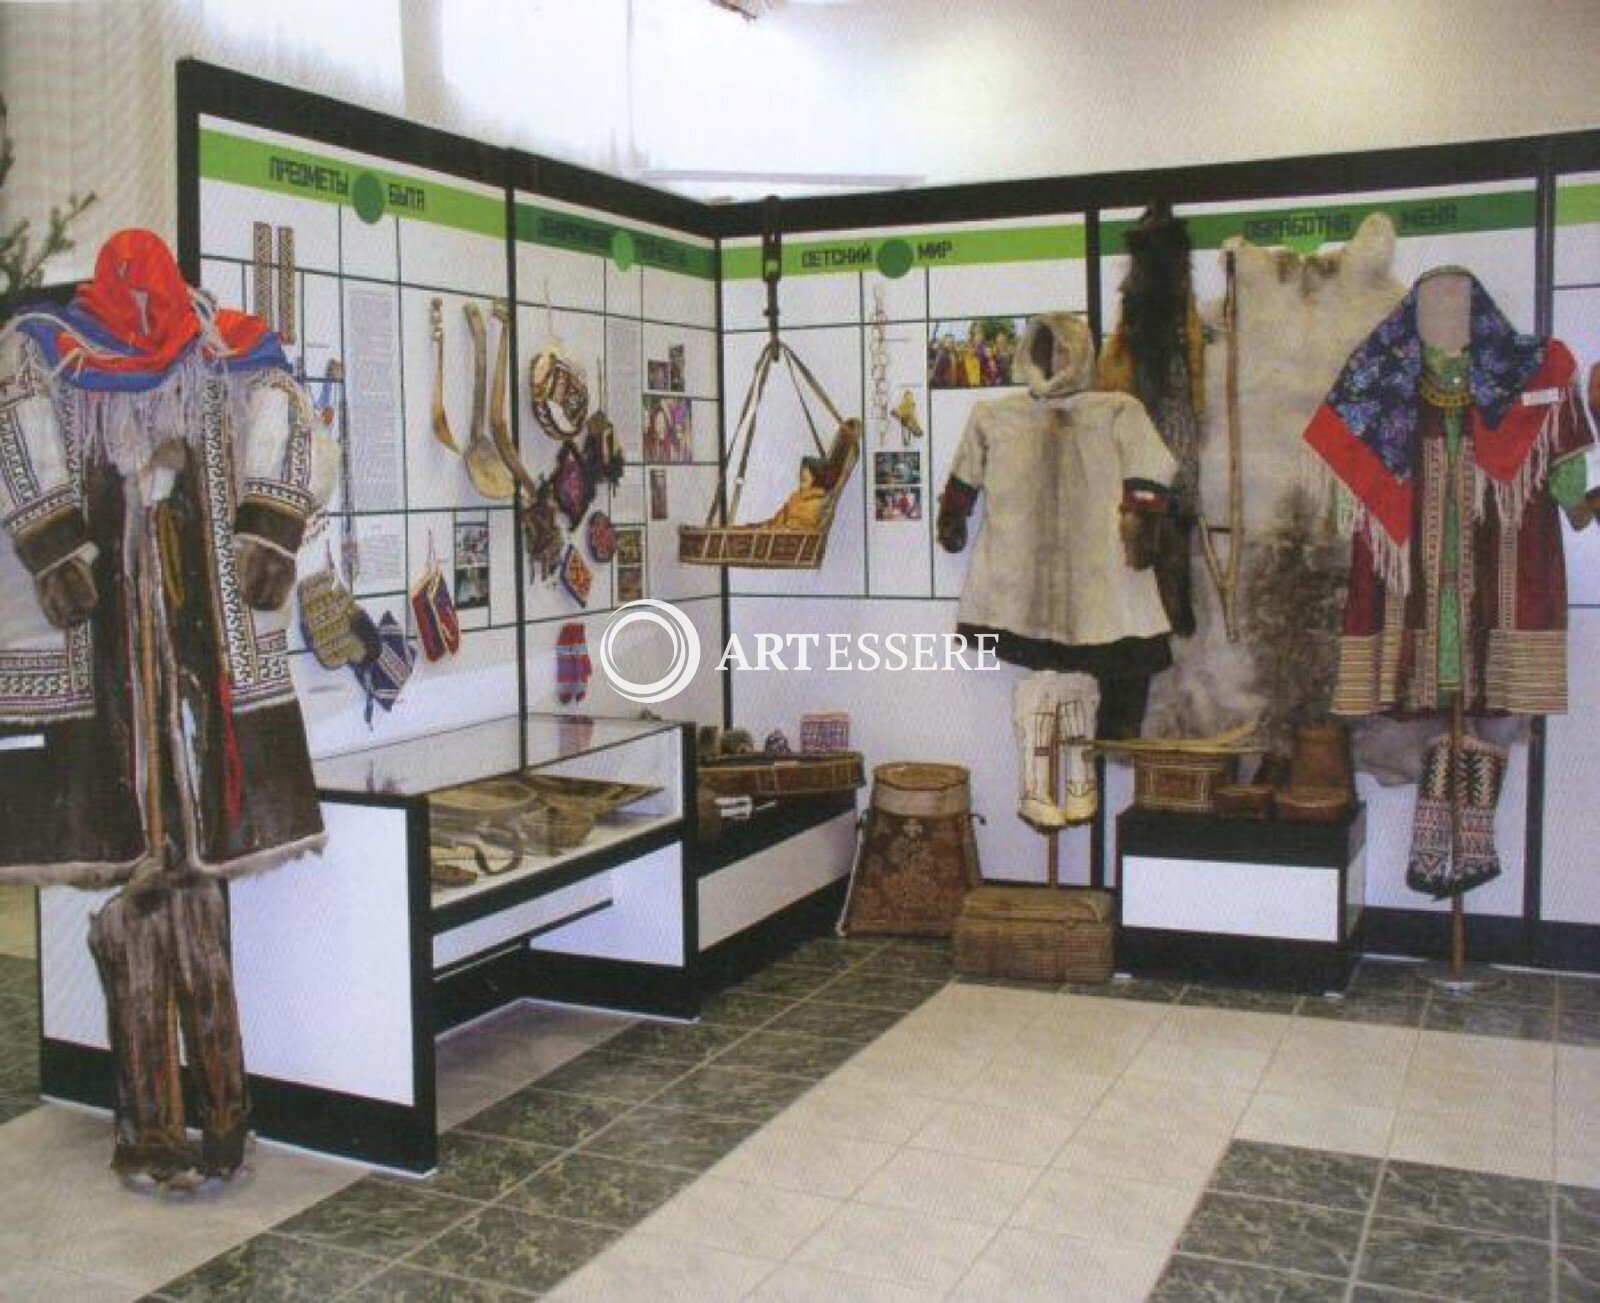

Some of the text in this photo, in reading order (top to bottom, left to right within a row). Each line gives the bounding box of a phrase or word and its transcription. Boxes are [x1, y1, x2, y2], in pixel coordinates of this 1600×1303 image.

[270, 157, 425, 211] ПРЕДМЕТЫ БЫТА
[918, 241, 952, 259] МИР
